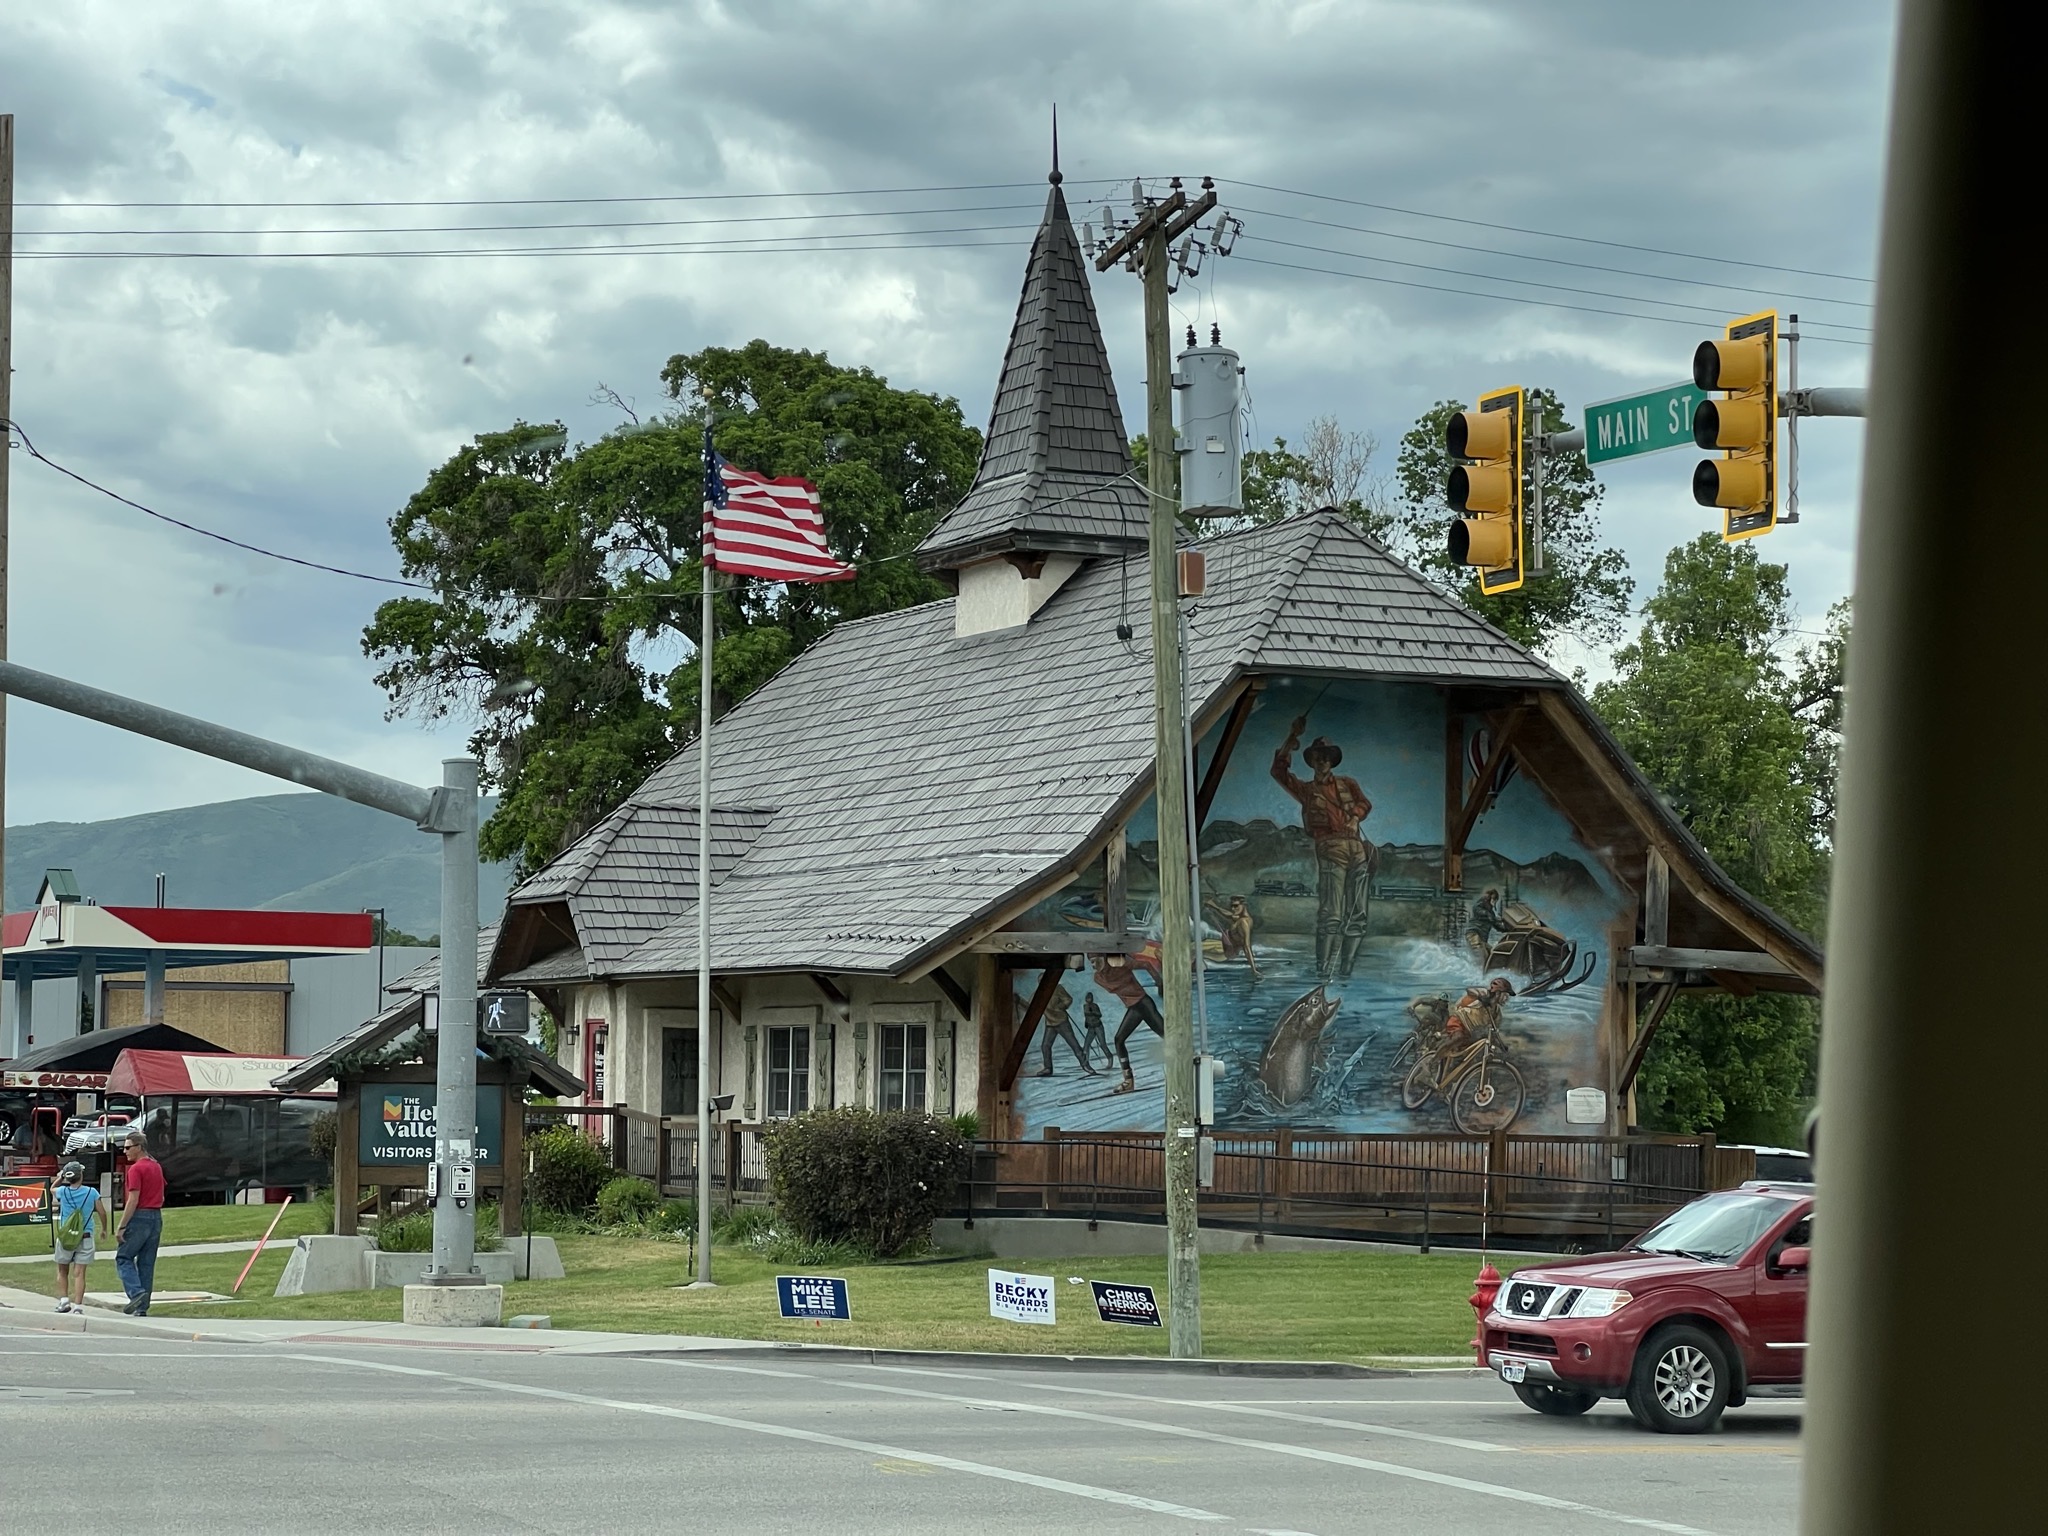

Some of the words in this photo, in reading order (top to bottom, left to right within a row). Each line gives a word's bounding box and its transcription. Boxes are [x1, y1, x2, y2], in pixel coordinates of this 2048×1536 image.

[1597, 405, 1649, 450] MAIN
[1668, 395, 1692, 434] ST
[403, 1097, 420, 1105] THE
[384, 1121, 437, 1138] Valle
[372, 1146, 433, 1158] VISITORS
[0, 1189, 20, 1198] PEN
[0, 1197, 40, 1210] TODAY
[791, 1284, 834, 1296] MIKE
[995, 1282, 1048, 1299] BECKY
[1105, 1288, 1148, 1302] CHRIS
[792, 1295, 836, 1309] LEE
[995, 1293, 1048, 1308] EDWARDS
[1107, 1297, 1155, 1312] HERROD
[808, 1308, 837, 1316] SENATE
